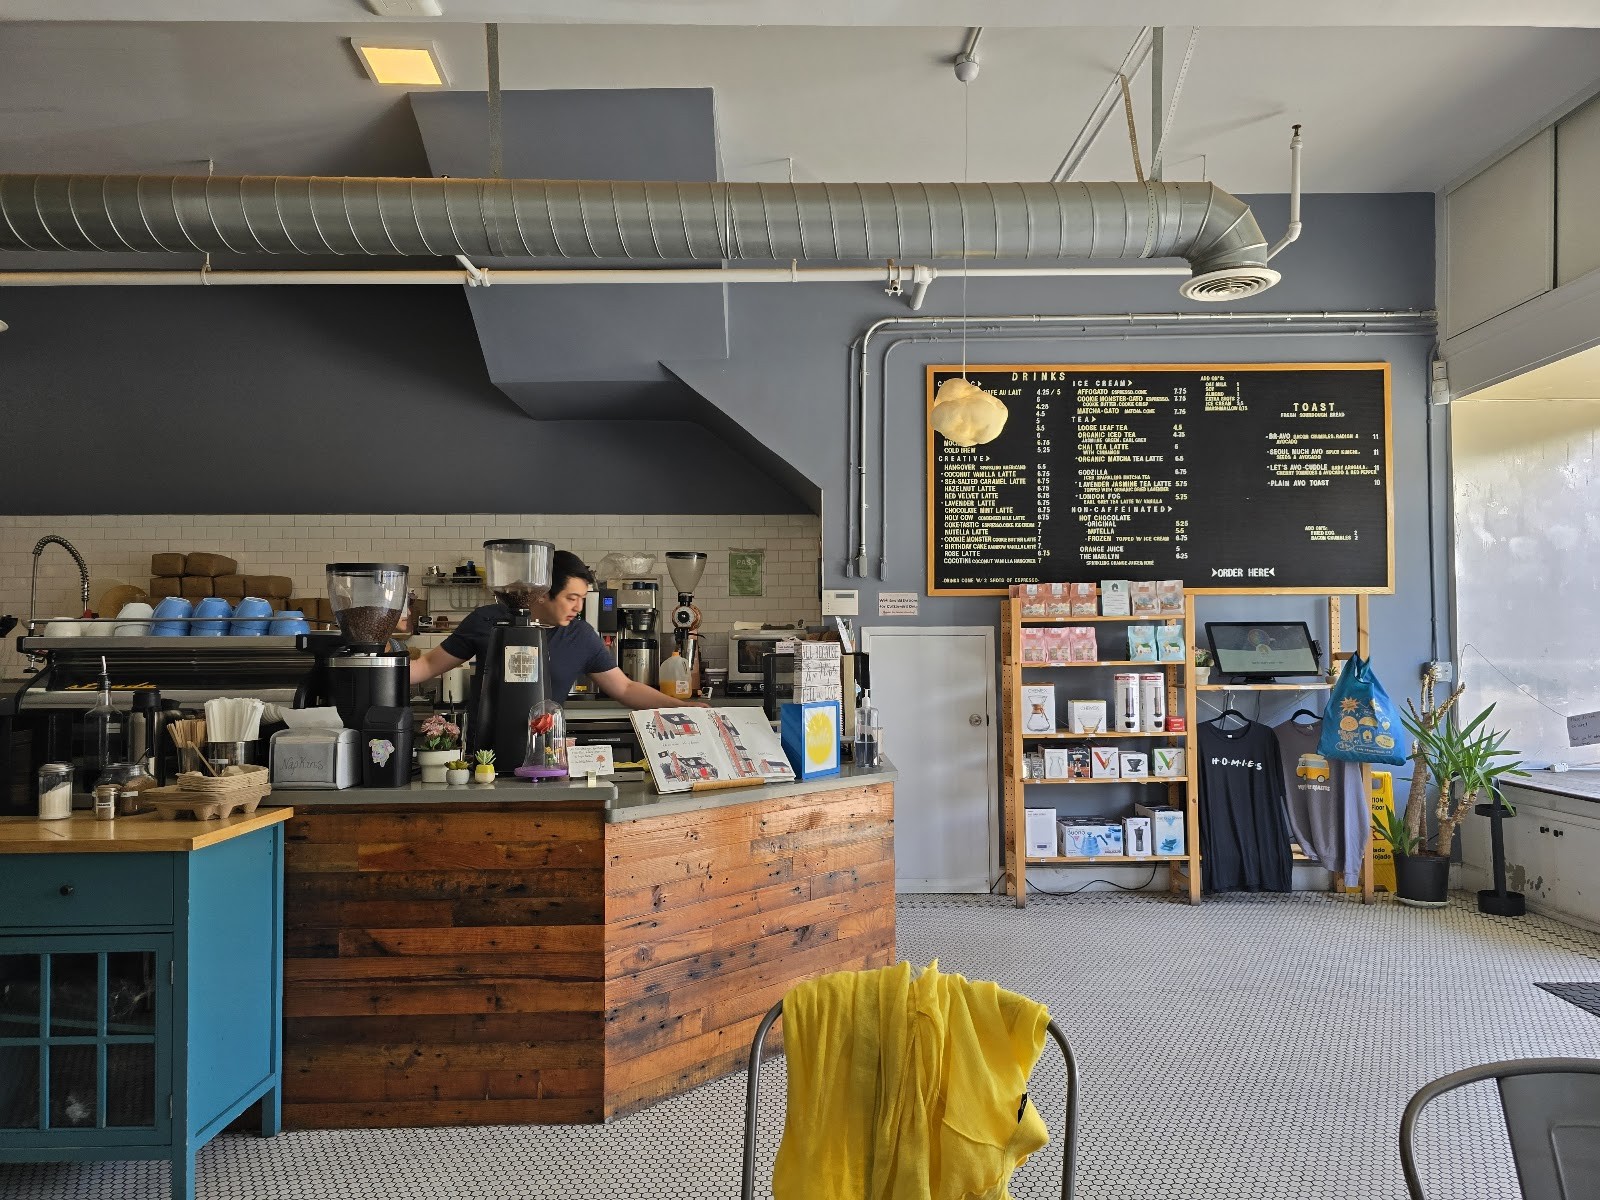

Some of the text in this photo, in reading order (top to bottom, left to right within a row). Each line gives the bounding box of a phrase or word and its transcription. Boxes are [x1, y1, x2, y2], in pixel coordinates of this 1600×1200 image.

[1012, 373, 1065, 381] DRINKS
[1293, 402, 1334, 412] TOAST
[1218, 568, 1269, 577] ORDER HERE
